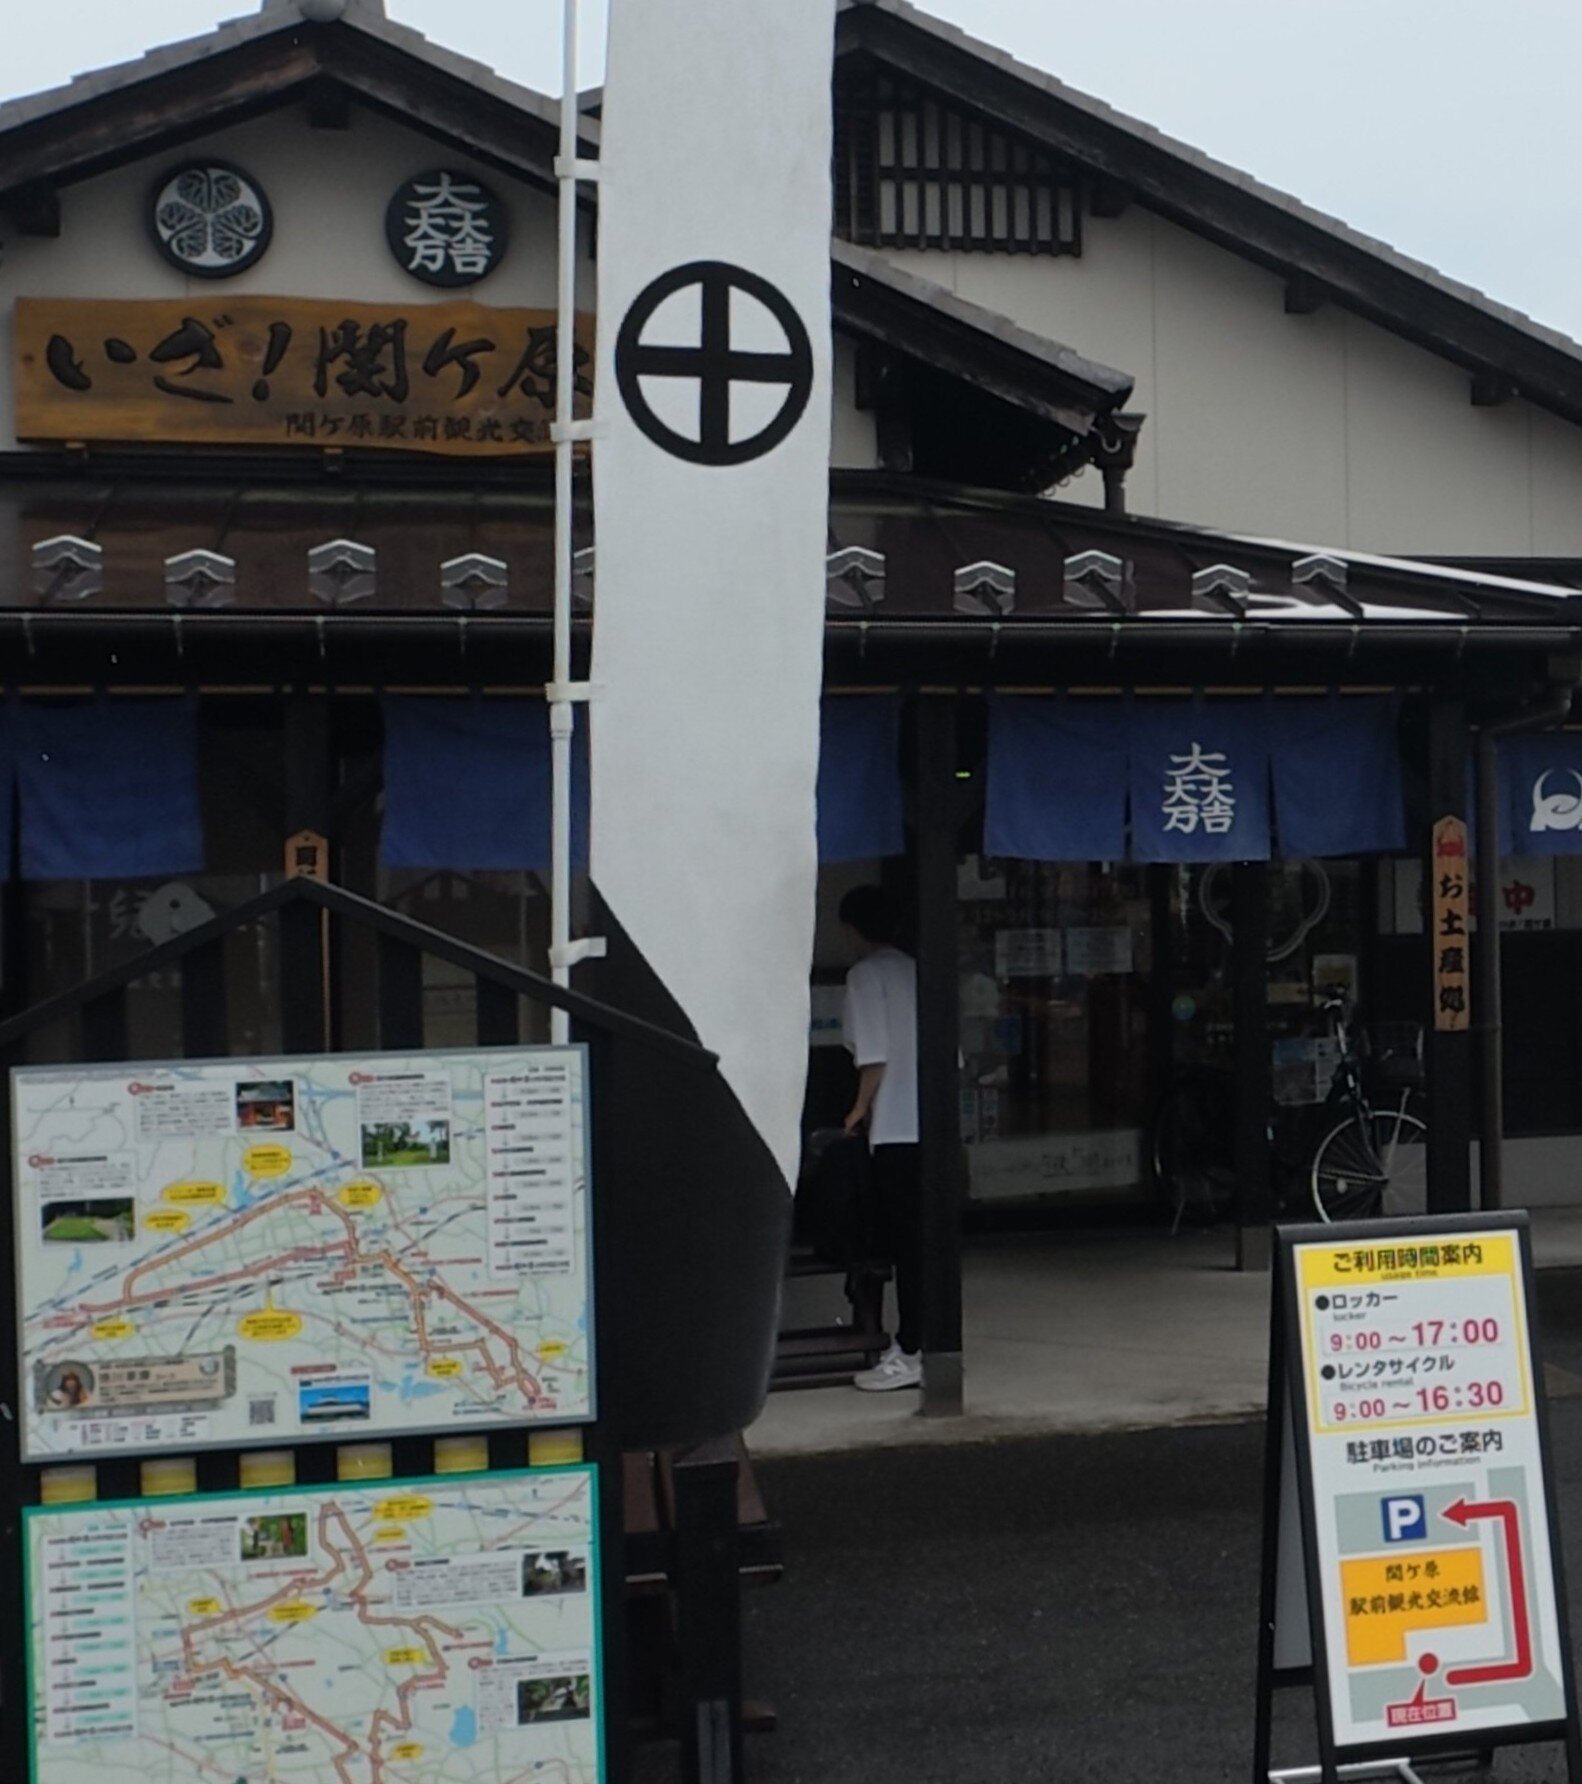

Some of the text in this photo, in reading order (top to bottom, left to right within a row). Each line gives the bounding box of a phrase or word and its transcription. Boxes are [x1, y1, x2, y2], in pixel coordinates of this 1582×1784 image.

[1333, 1244, 1482, 1273] ご利用時間案内
[1416, 1269, 1438, 1279] time
[1381, 1377, 1414, 1388] rental
[1347, 1430, 1503, 1464] 駐車場のご案内
[1387, 1499, 1421, 1540] P
